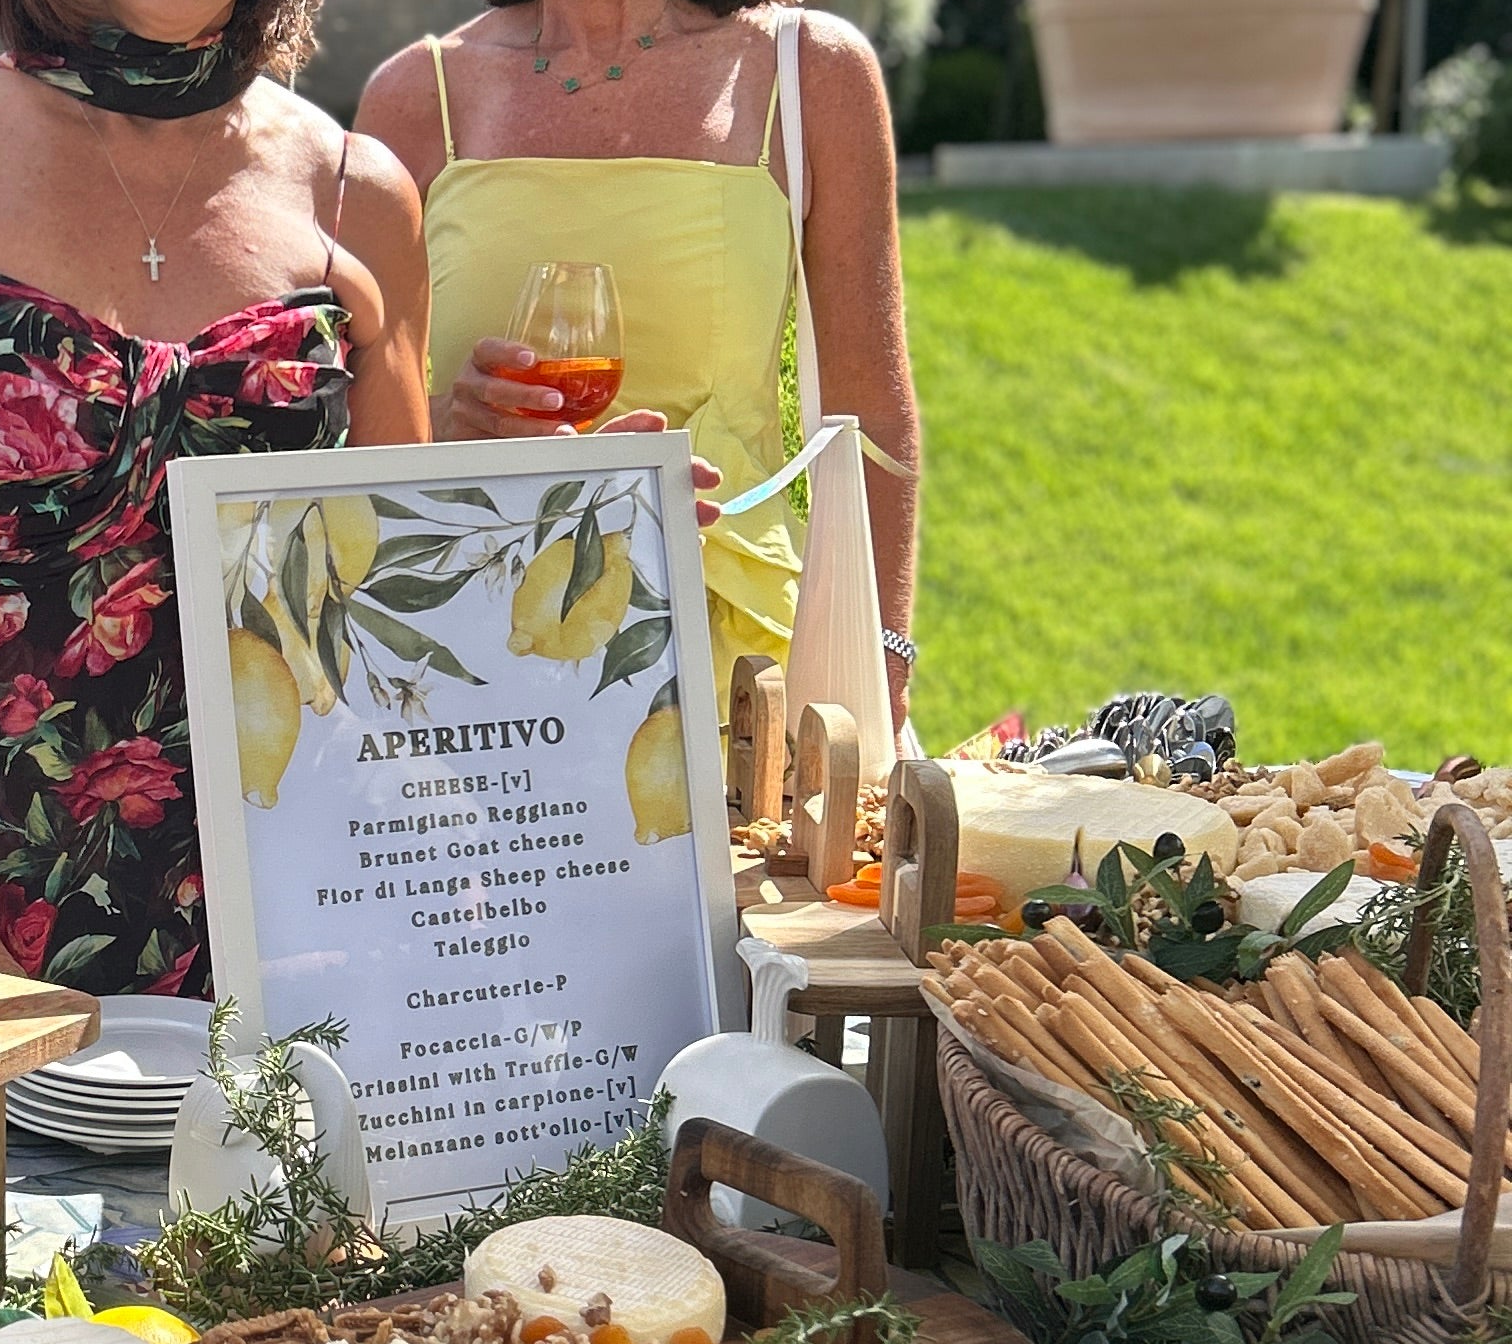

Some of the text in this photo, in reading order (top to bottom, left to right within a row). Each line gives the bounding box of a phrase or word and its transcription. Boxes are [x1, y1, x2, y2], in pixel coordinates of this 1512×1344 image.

[357, 716, 565, 762] APERITIVO
[402, 769, 531, 799] CHEESE-[v]
[349, 800, 587, 837] Parmigiano Reggiano
[359, 832, 584, 868] Brunet Goat cheese
[317, 859, 630, 906] Fior di Langa Sheep cheese
[411, 898, 547, 928] Castelbelbo
[434, 933, 530, 957] Taleggio
[406, 974, 567, 1009] Charcuterie-P
[400, 1020, 582, 1059] Focaccia-G/W/P
[350, 1045, 638, 1099] Grissini with Truffle-G/W
[358, 1076, 636, 1131] Zucchini in carpione-[v]
[366, 1133, 485, 1164] Melanzane
